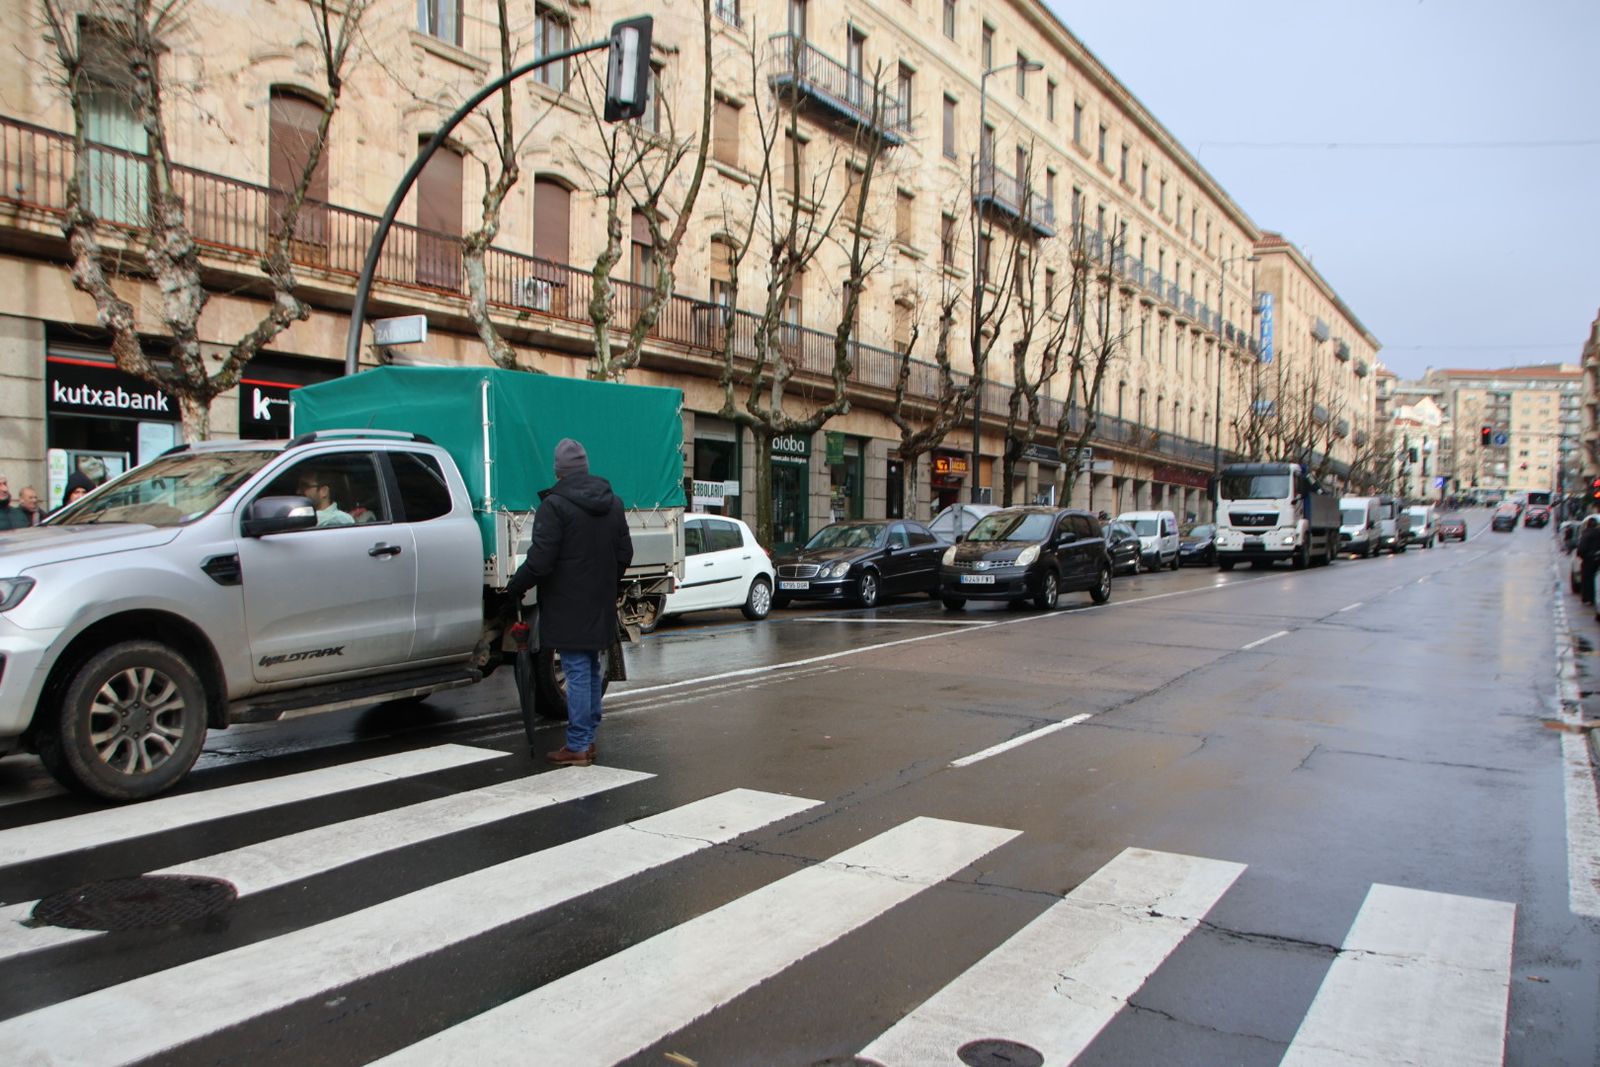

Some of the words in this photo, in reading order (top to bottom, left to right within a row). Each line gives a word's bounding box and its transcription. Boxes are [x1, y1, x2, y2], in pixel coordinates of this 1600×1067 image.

[53, 379, 169, 412] kutxabank
[253, 387, 272, 421] k
[692, 482, 724, 498] ERBOLARIO
[258, 645, 346, 667] WILDTRAK
